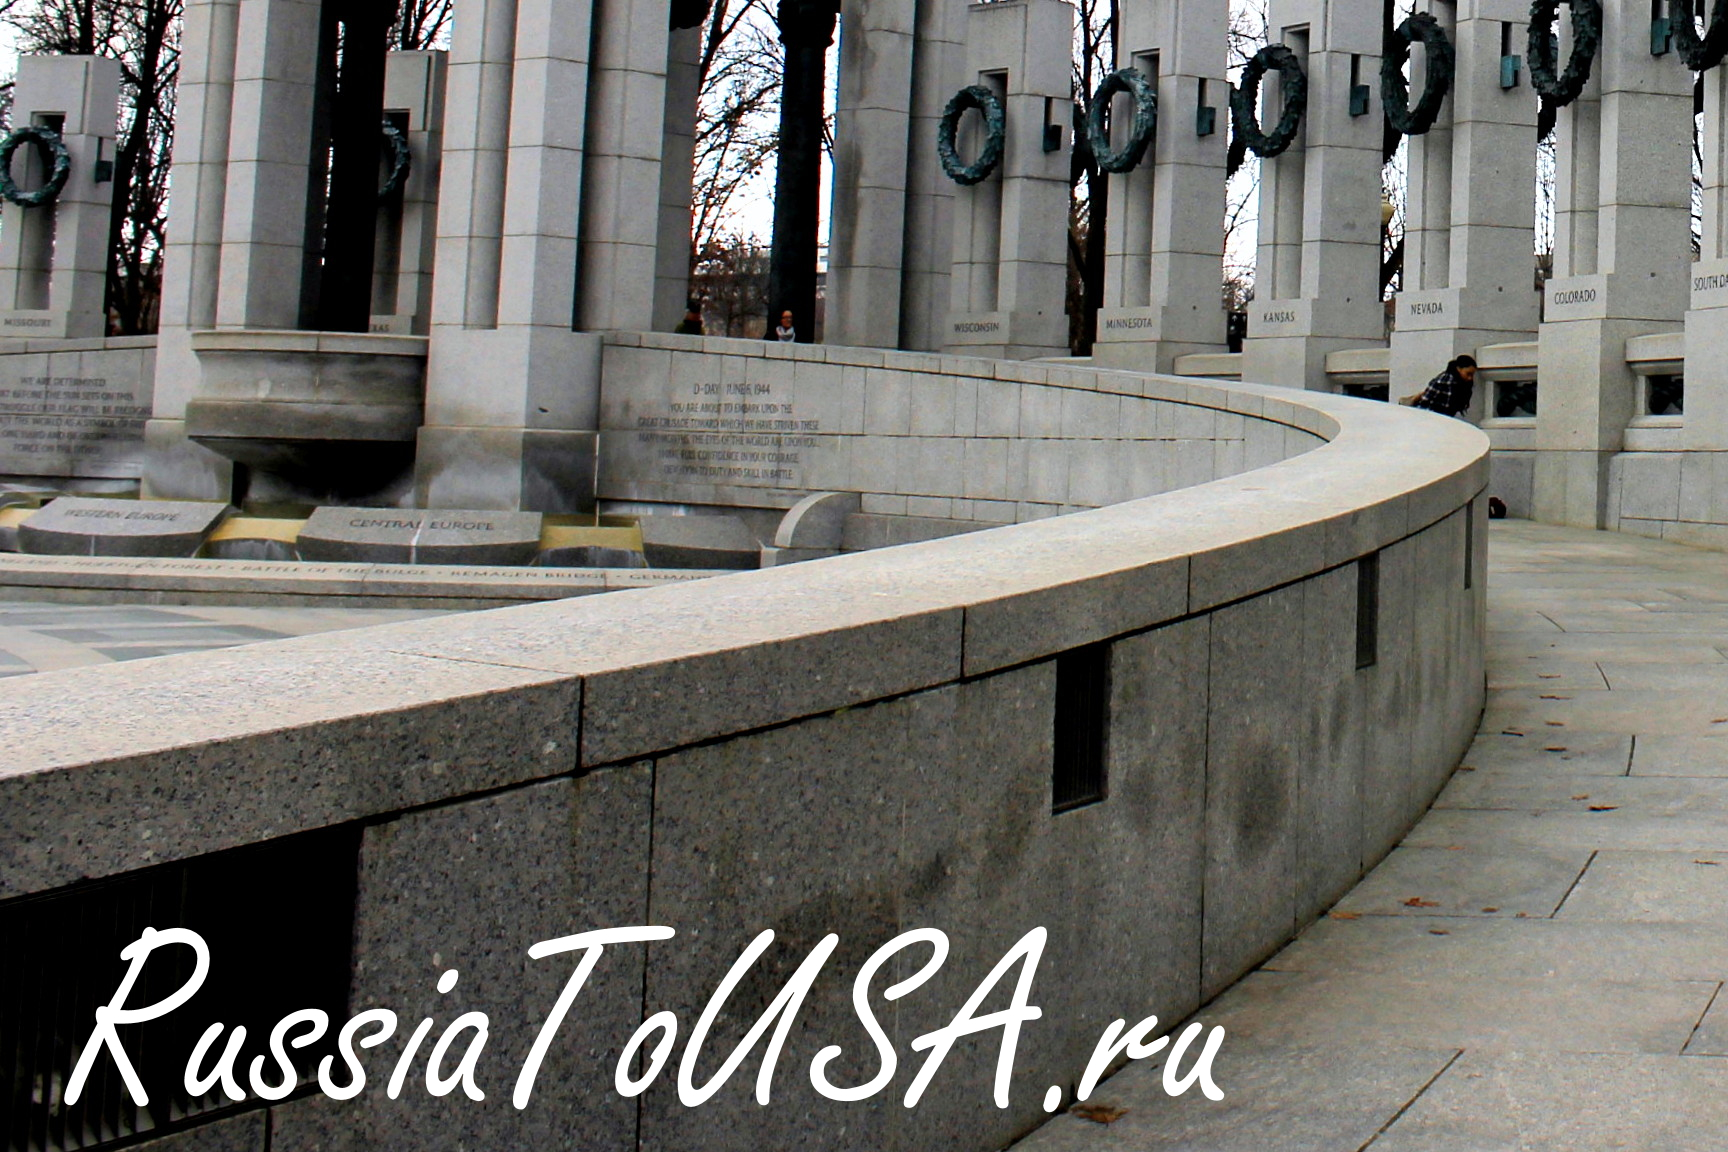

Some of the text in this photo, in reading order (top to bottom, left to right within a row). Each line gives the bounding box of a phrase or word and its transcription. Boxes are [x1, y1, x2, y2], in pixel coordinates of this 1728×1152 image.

[1693, 275, 1718, 291] SOUTH
[1553, 288, 1597, 306] COLORADO
[1410, 301, 1444, 317] NEVADA
[4, 318, 52, 328] MISSOURI
[1262, 310, 1296, 324] KANSAS
[953, 321, 1000, 334] WISCONSIN
[1105, 317, 1154, 331] MINNESOTA
[754, 384, 771, 395] 1944
[64, 509, 179, 522] WESTERN EUROPE
[349, 518, 495, 531] CENTRAL EUROPE
